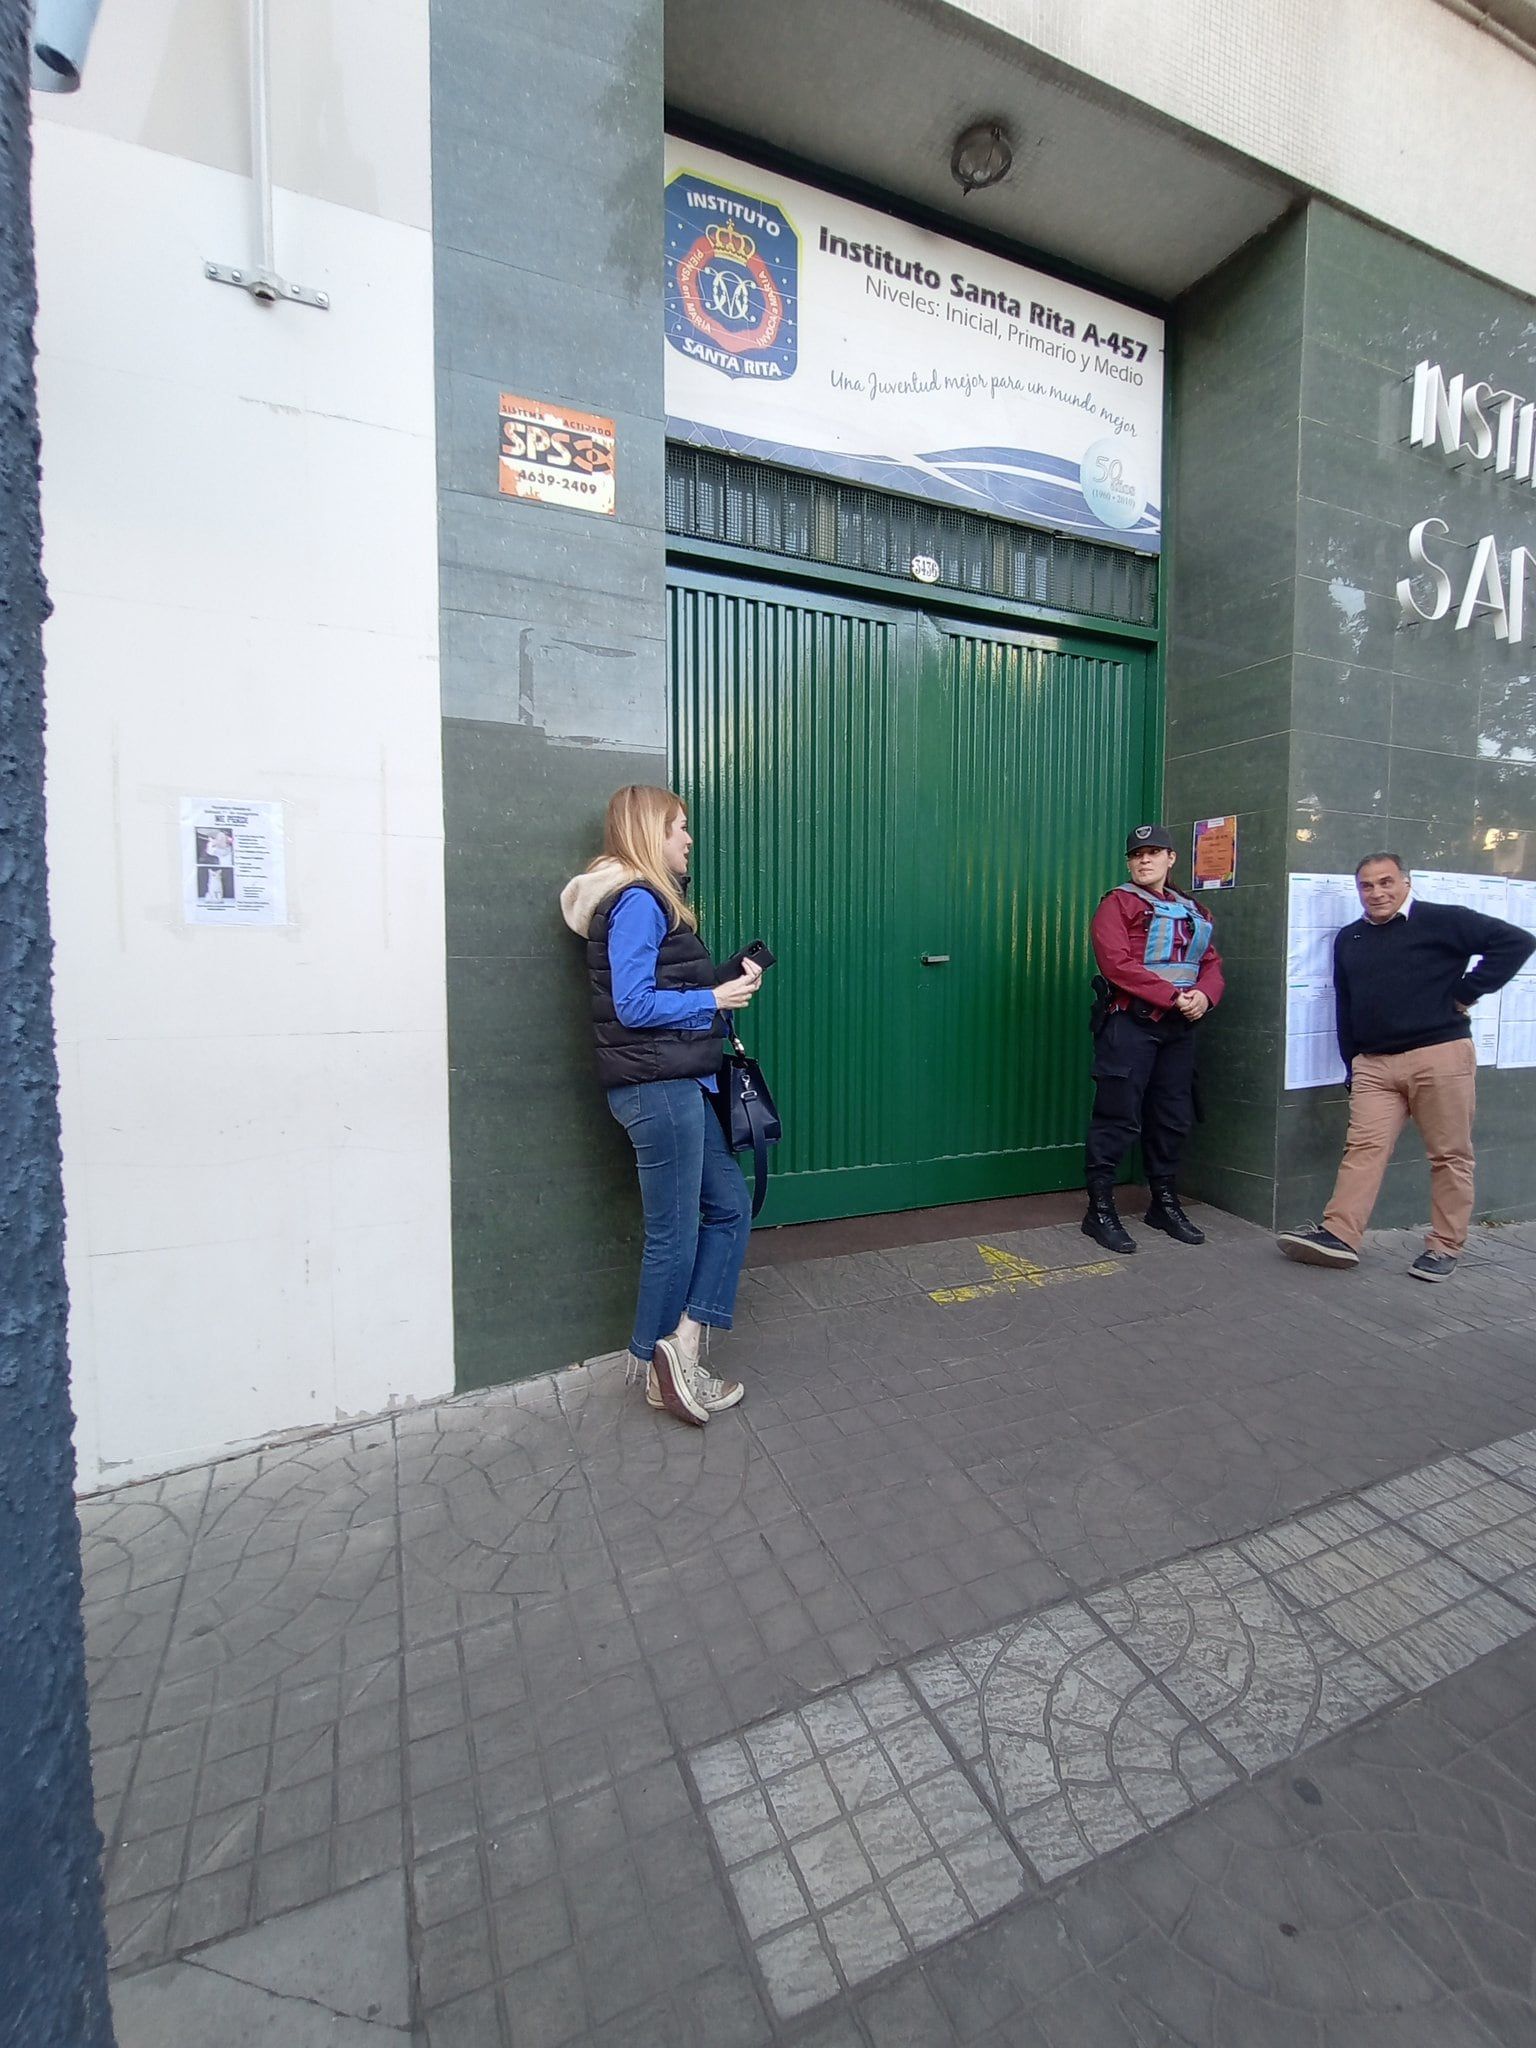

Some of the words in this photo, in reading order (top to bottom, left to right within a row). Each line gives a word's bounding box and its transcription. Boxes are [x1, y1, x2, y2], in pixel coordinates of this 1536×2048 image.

[686, 191, 780, 237] INSTITUTO
[681, 248, 705, 282] PIENSA
[759, 271, 778, 310] MARIA
[819, 225, 941, 290] Instituto
[950, 273, 1021, 319] Santa
[1029, 301, 1075, 339] Rita
[1081, 322, 1148, 363] A-457
[686, 302, 712, 334] MARIA
[755, 314, 779, 347] INVOCA
[866, 275, 940, 317] Niveles:
[946, 302, 1002, 340] Inicial,
[1008, 323, 1076, 363] Primario
[1080, 353, 1091, 373] y
[1094, 355, 1143, 386] Medio
[682, 338, 740, 372] SANTA
[743, 359, 782, 377] RITA
[501, 405, 545, 421] SISTEMA
[831, 369, 865, 392] Una
[868, 369, 942, 402] Juventud
[945, 373, 988, 398] mejor
[991, 376, 1025, 399] para
[1027, 382, 1047, 396] un
[1050, 386, 1096, 414] mundo
[1100, 407, 1137, 437] mejor
[502, 420, 572, 467] SPS
[1410, 360, 1536, 489] INSTI
[518, 469, 597, 494] 4639-2409
[1093, 455, 1123, 482] 50
